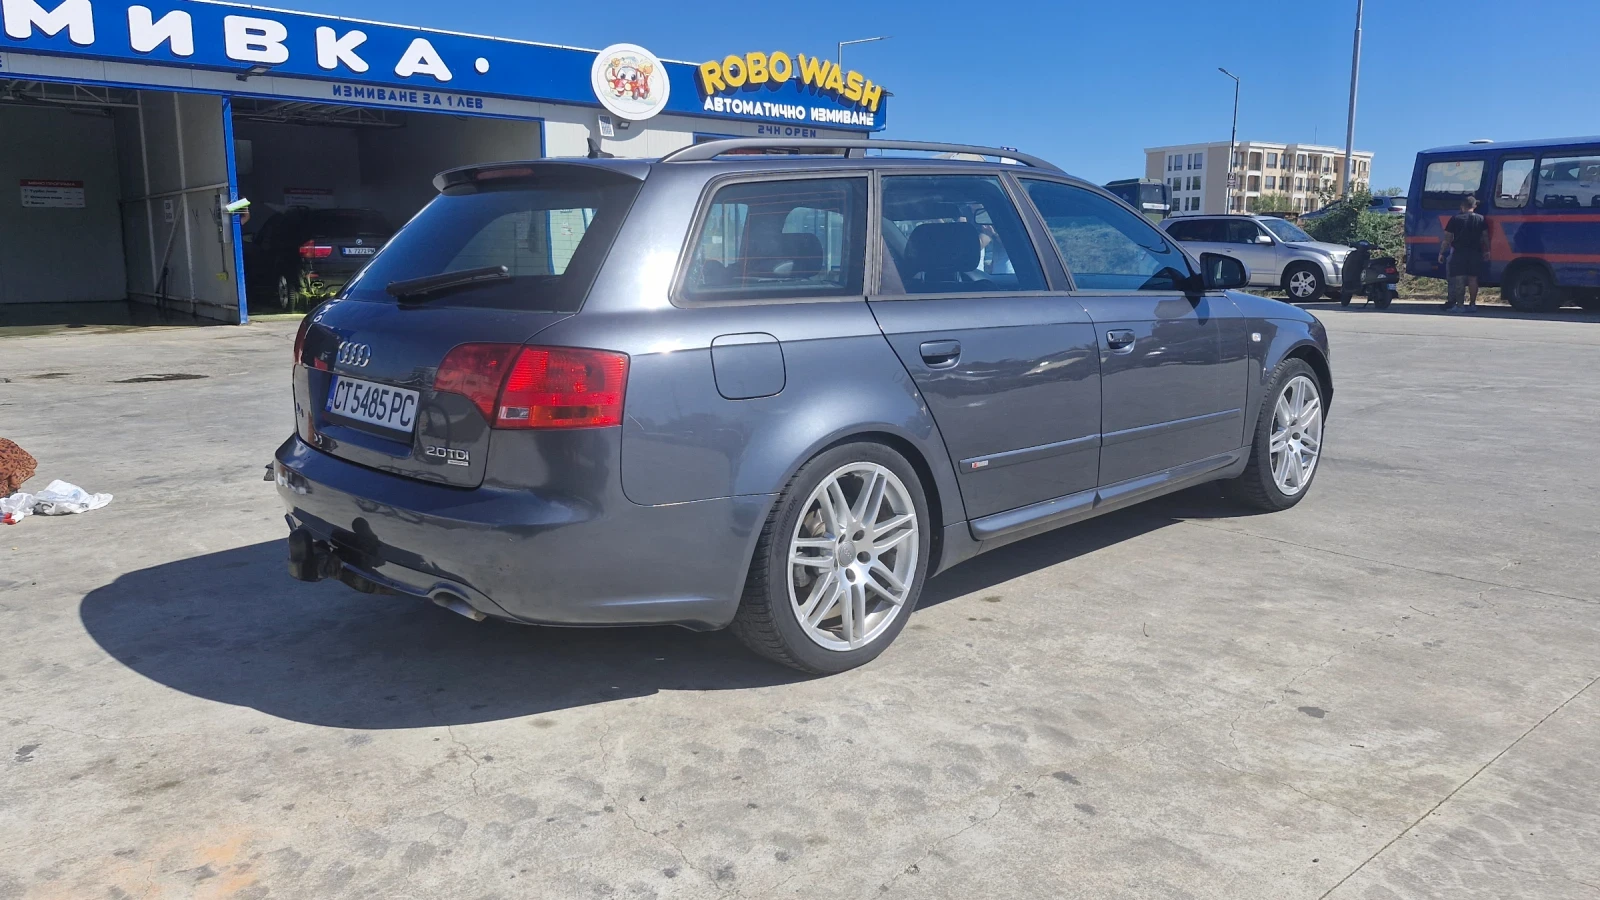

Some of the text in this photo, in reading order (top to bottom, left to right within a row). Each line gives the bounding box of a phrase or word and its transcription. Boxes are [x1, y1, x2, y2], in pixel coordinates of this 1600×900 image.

[700, 50, 882, 112] ROBO WASH
[332, 84, 483, 109] ИЗМИВАНЕ ЗА 1 ЛЕВ
[703, 96, 874, 126] АВТОМАТИЧНО ИЗМИВАНЕ
[757, 124, 816, 138] 24H OPEN
